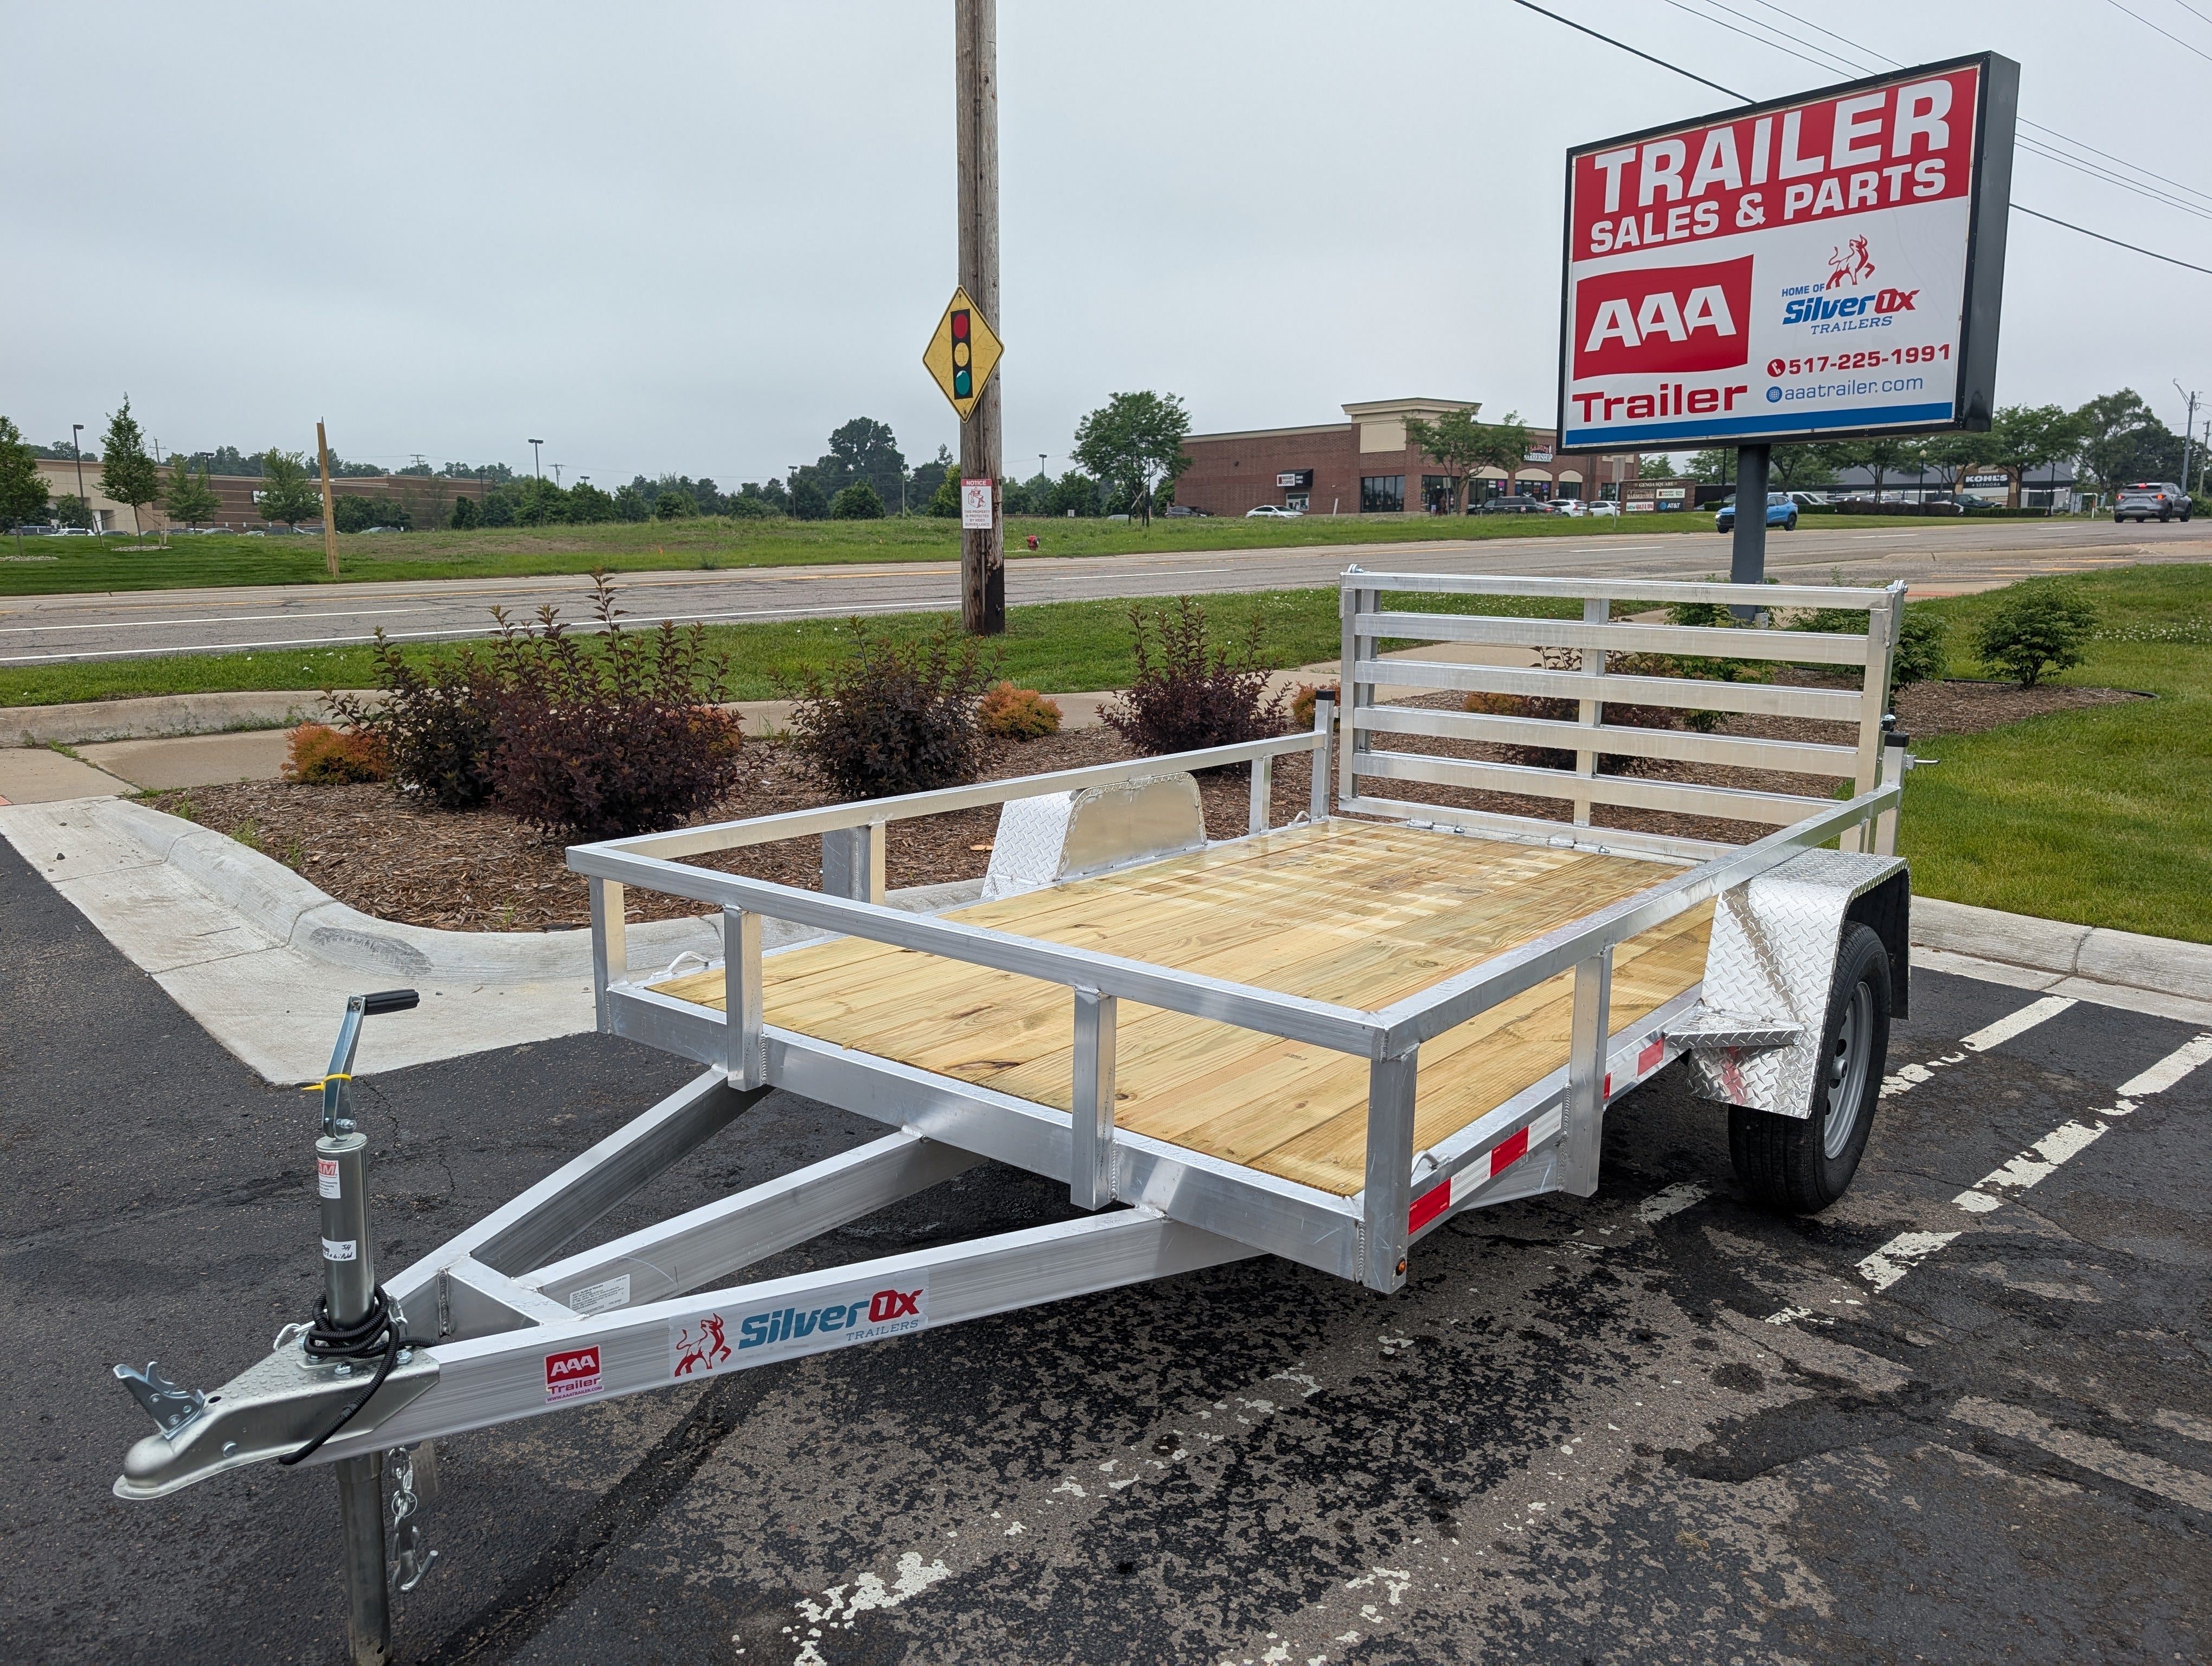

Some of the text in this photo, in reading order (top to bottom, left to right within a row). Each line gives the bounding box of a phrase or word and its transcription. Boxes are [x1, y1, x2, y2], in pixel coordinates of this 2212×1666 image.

[1594, 79, 1953, 214] TRAILER
[1590, 158, 1946, 253] SALES & PARTS
[1782, 283, 1825, 297] HOME OF
[1584, 285, 1737, 353] AAA
[1811, 316, 1893, 335] TRAILERS
[1789, 343, 1950, 375] 517-225-1991
[1785, 377, 1923, 400] aaatrailer.com
[1572, 383, 1748, 422] Trailer
[1965, 474, 2008, 483] KOHL'S
[846, 1319, 918, 1342] TRAILERS
[550, 1355, 596, 1377] AAA
[547, 1386, 602, 1402] WWW.AAATRAILER.COM
[548, 1377, 601, 1394] Trailer
